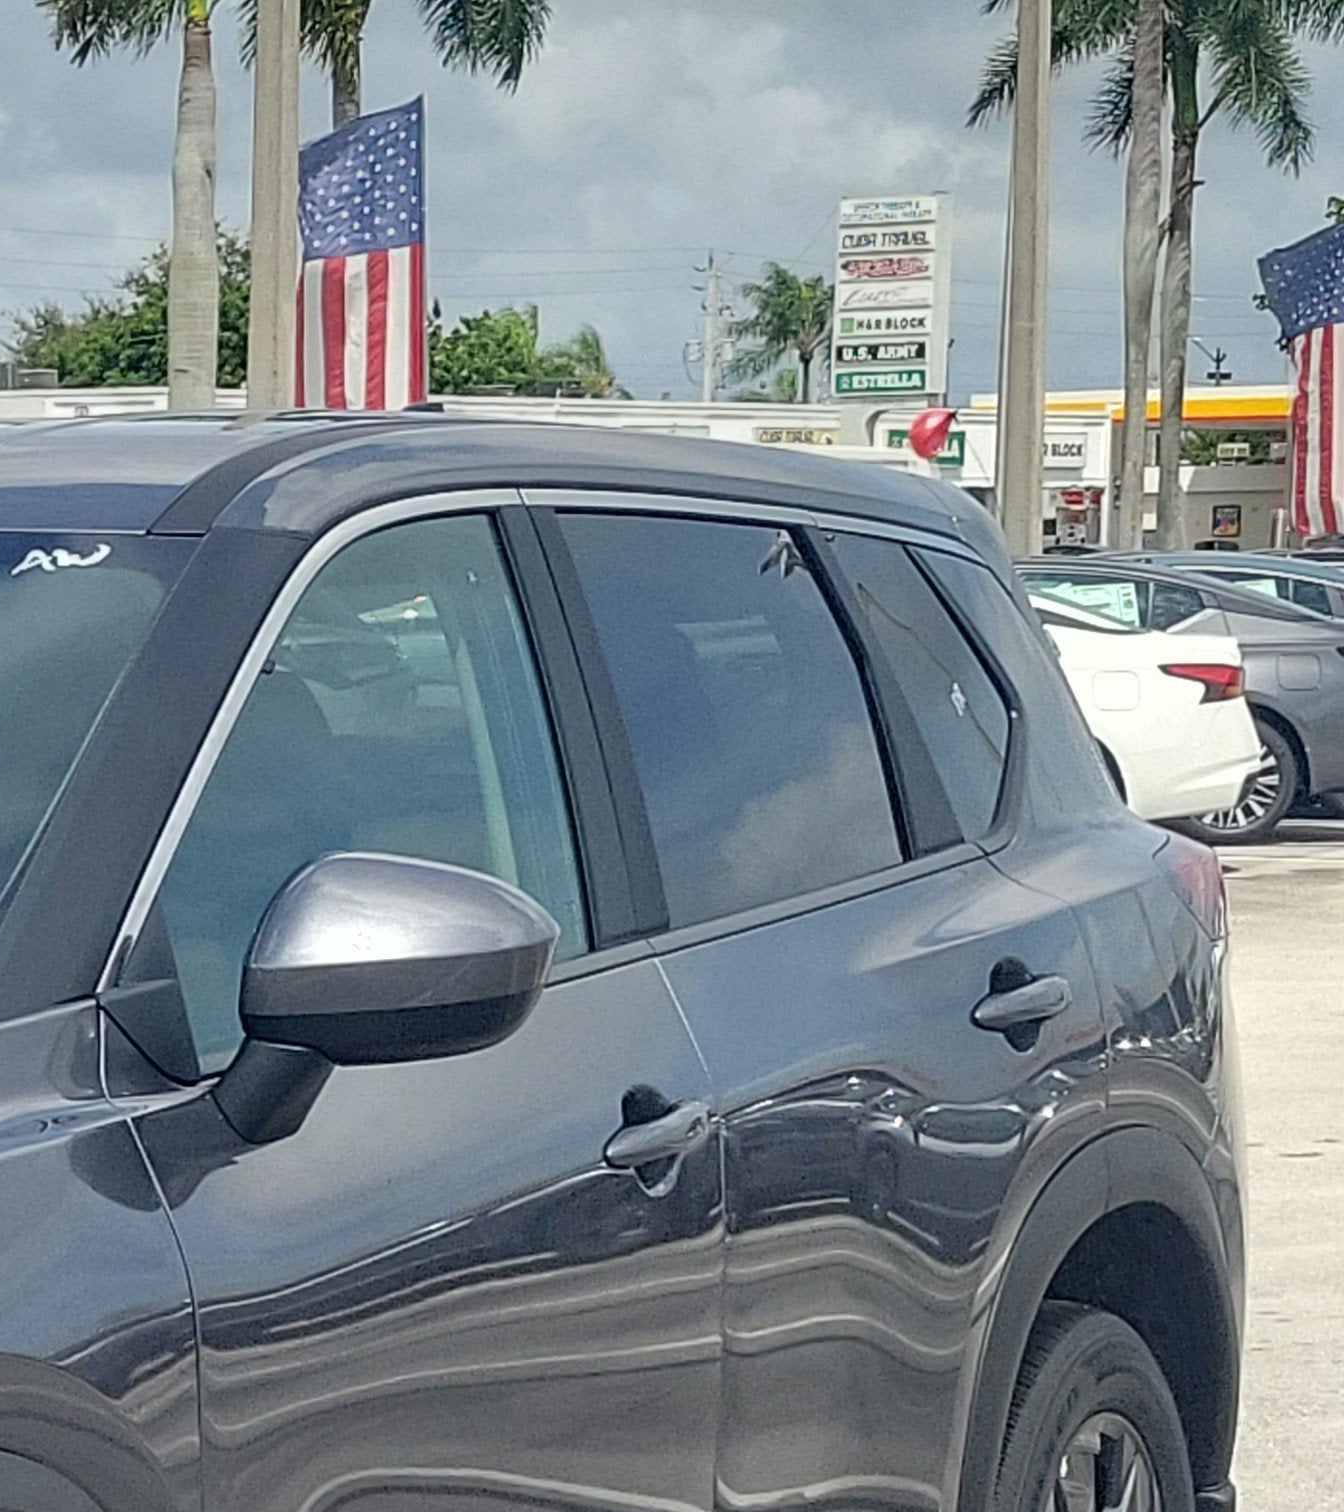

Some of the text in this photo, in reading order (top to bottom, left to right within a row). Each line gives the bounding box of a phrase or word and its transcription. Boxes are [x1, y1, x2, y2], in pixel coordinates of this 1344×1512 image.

[885, 317, 927, 330] BLOCK
[842, 344, 919, 361] U.S. ARMY
[852, 373, 922, 389] ESTRELLA
[1051, 443, 1083, 457] BLOCK
